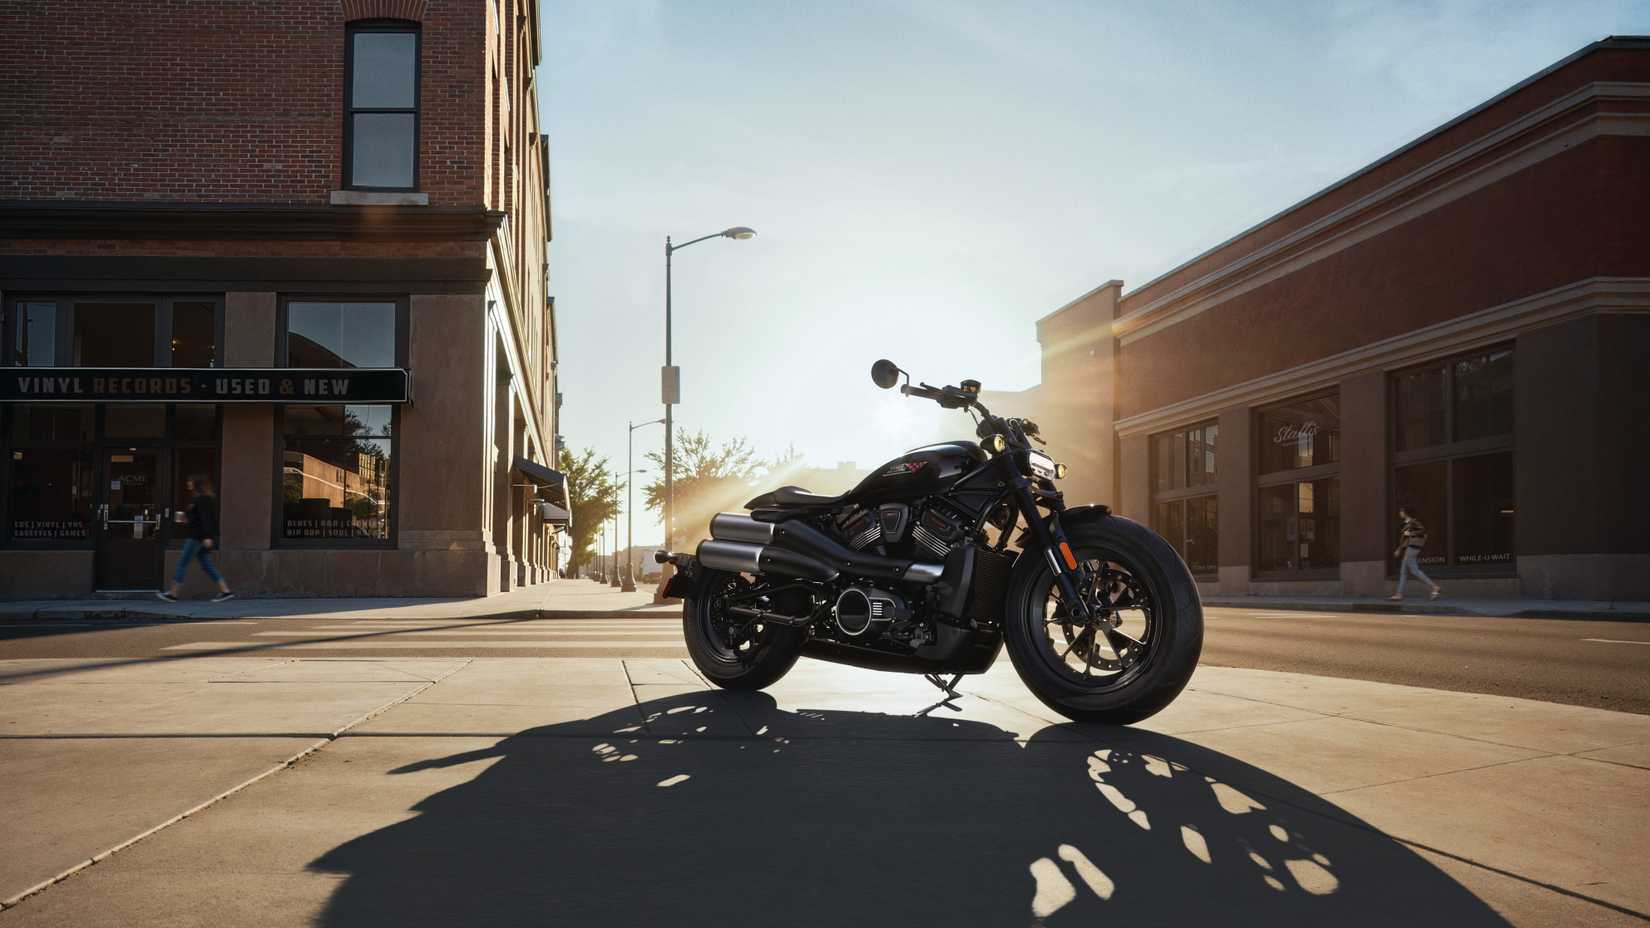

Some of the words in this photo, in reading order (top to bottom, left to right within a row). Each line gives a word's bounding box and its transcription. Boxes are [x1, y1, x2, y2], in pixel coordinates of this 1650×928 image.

[17, 376, 84, 393] VINYL
[93, 376, 192, 394] RECORDS
[215, 377, 271, 395] USED
[279, 378, 295, 395] &
[304, 378, 351, 395] NEW
